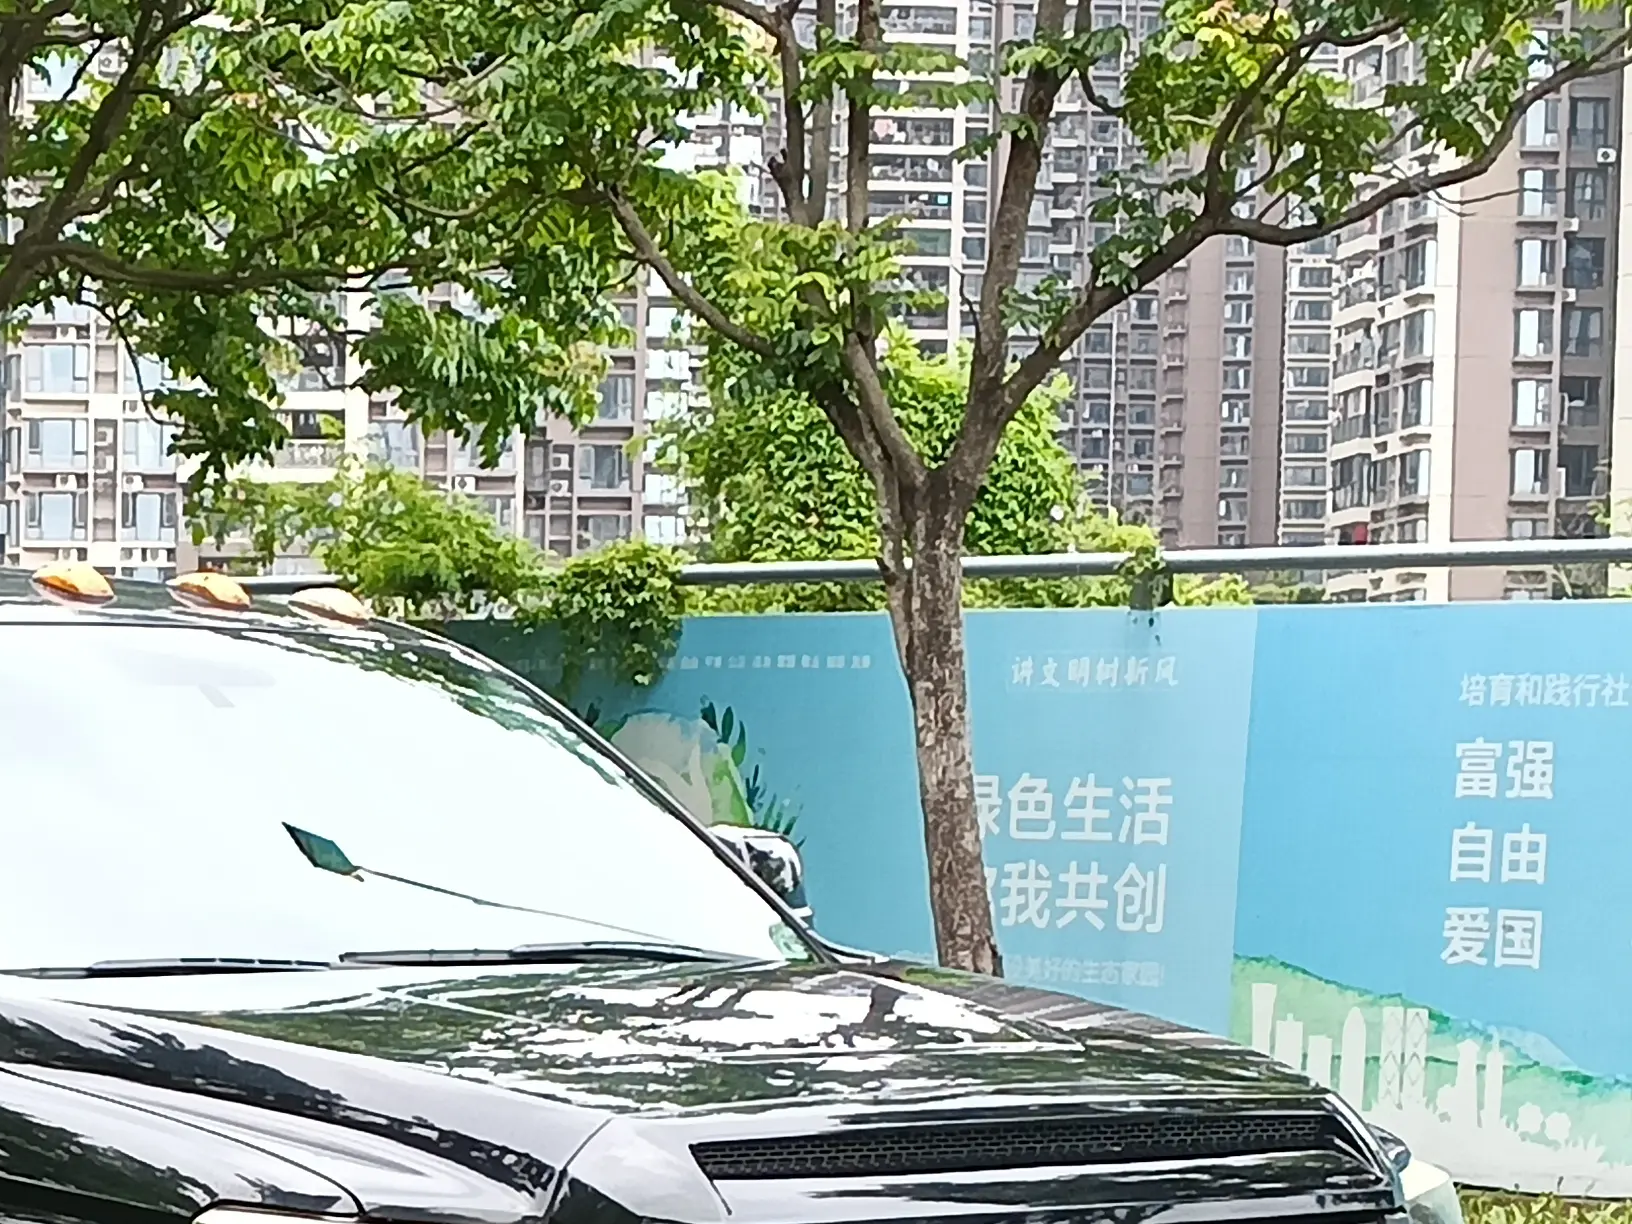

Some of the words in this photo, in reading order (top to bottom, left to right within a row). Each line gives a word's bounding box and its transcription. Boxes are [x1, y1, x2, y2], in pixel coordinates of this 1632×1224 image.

[1458, 672, 1629, 708] 培育和践行社
[1455, 737, 1554, 800] 富强
[1449, 821, 1548, 885] 自由
[984, 858, 1167, 934] 我共创
[1439, 906, 1543, 970] 爱国
